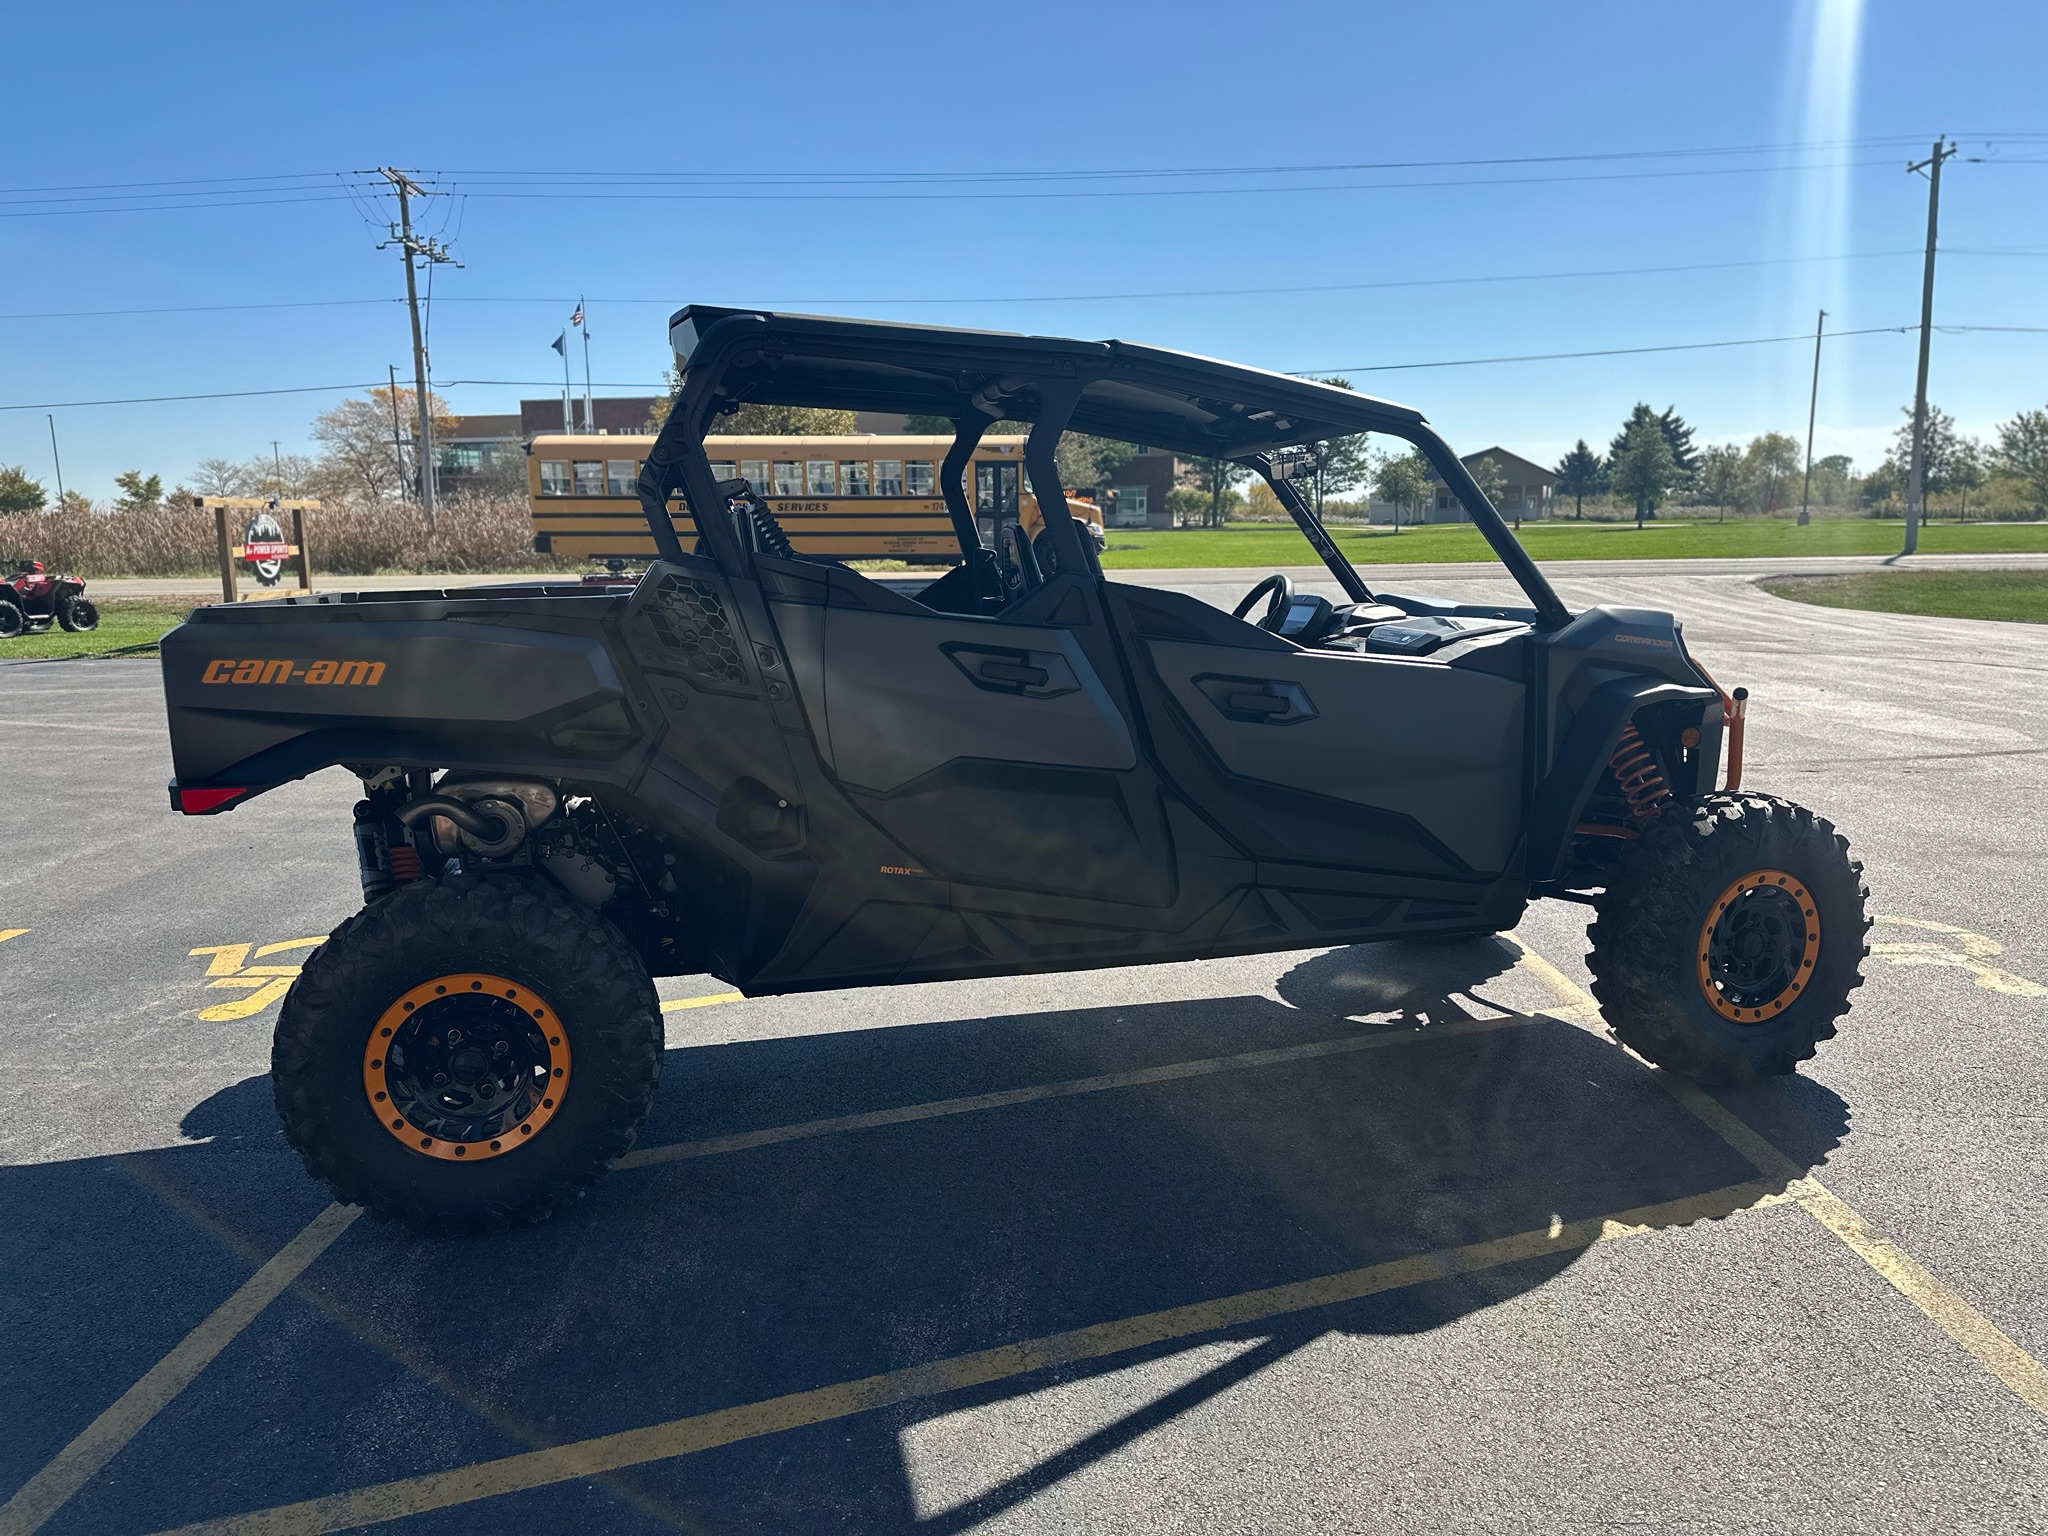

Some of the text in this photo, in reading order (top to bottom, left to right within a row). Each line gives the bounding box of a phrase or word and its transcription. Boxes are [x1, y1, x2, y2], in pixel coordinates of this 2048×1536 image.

[777, 502, 829, 512] SERVICES
[254, 545, 271, 555] POWER
[271, 545, 288, 554] SPORTS
[1614, 634, 1673, 648] COMMANDER
[202, 659, 386, 686] can-am
[880, 866, 911, 876] ROTAX
